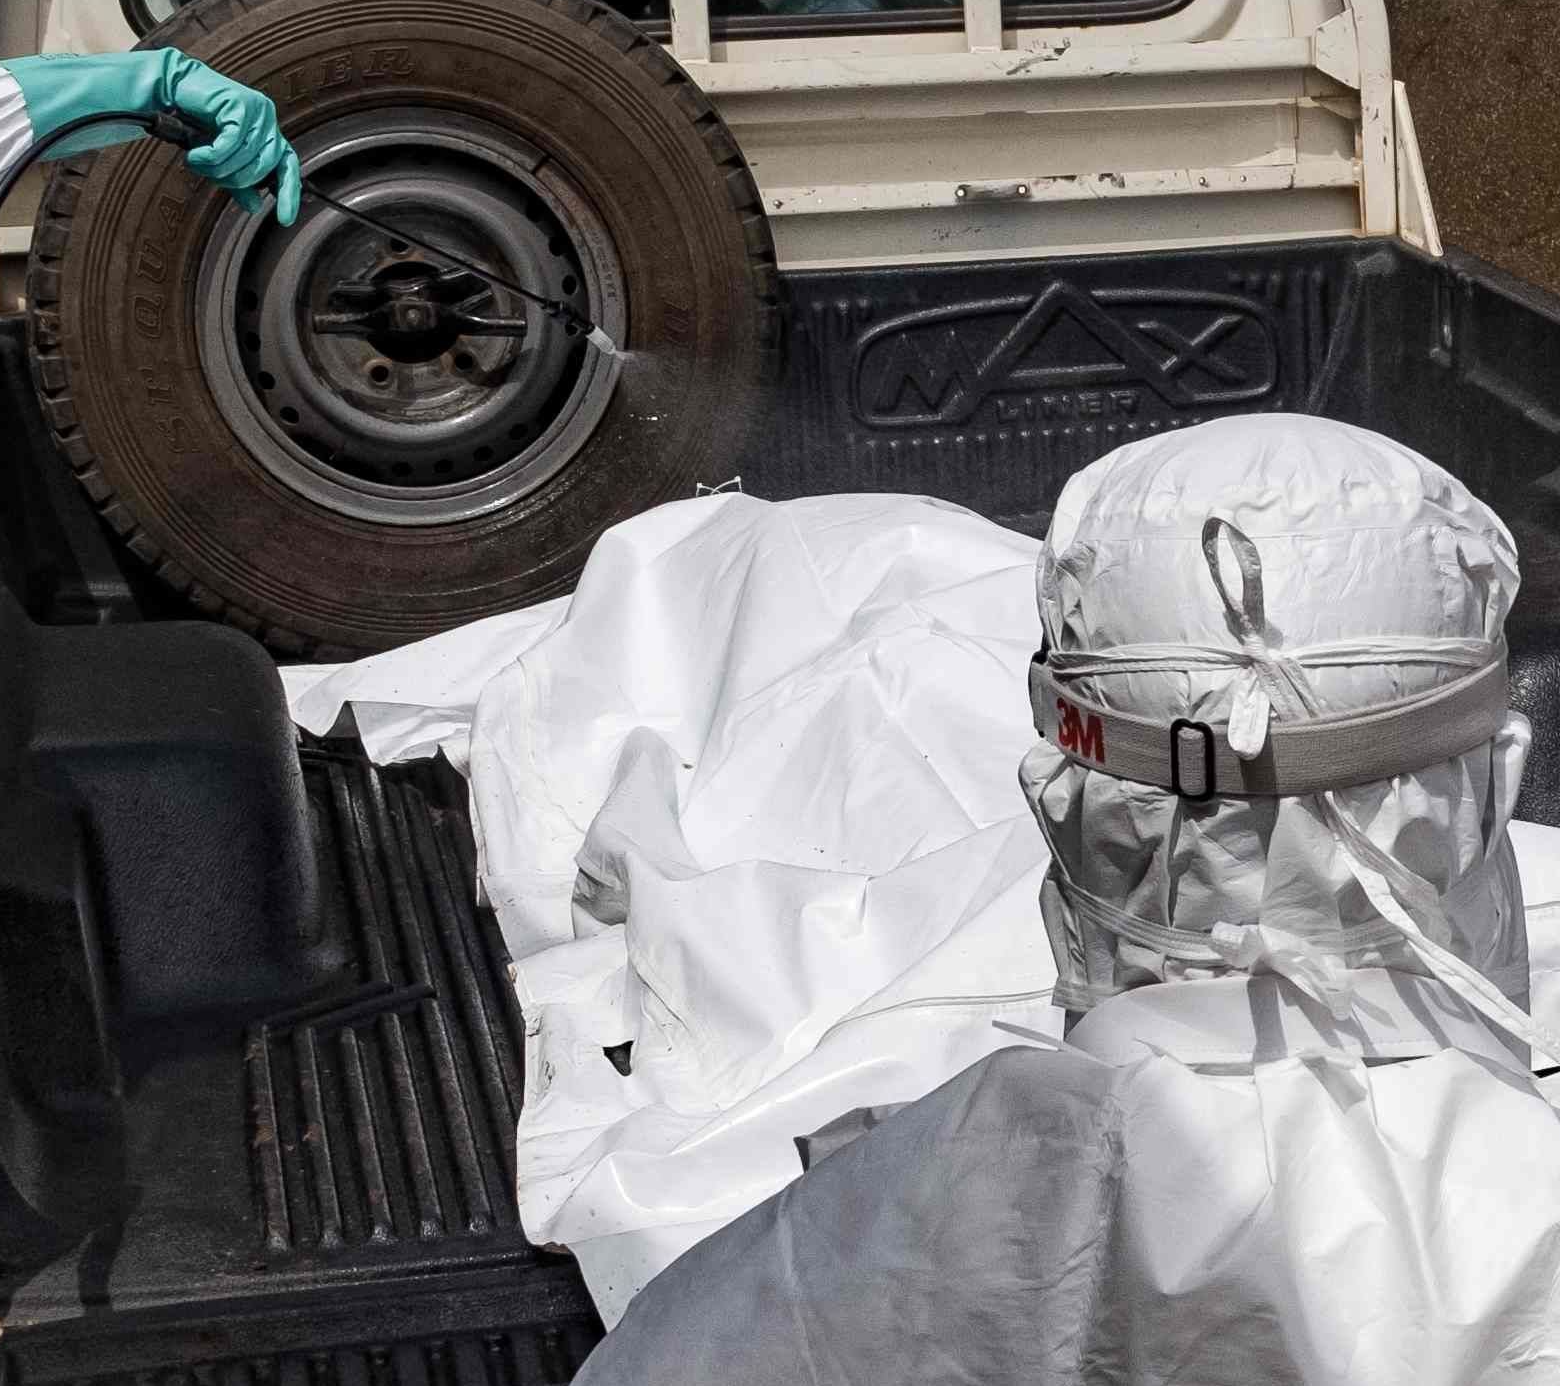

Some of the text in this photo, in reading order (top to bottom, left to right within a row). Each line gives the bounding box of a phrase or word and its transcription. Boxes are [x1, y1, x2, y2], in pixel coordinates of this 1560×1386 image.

[870, 281, 1245, 414] MAX
[996, 388, 1141, 425] LINER
[1056, 696, 1106, 765] 3M
